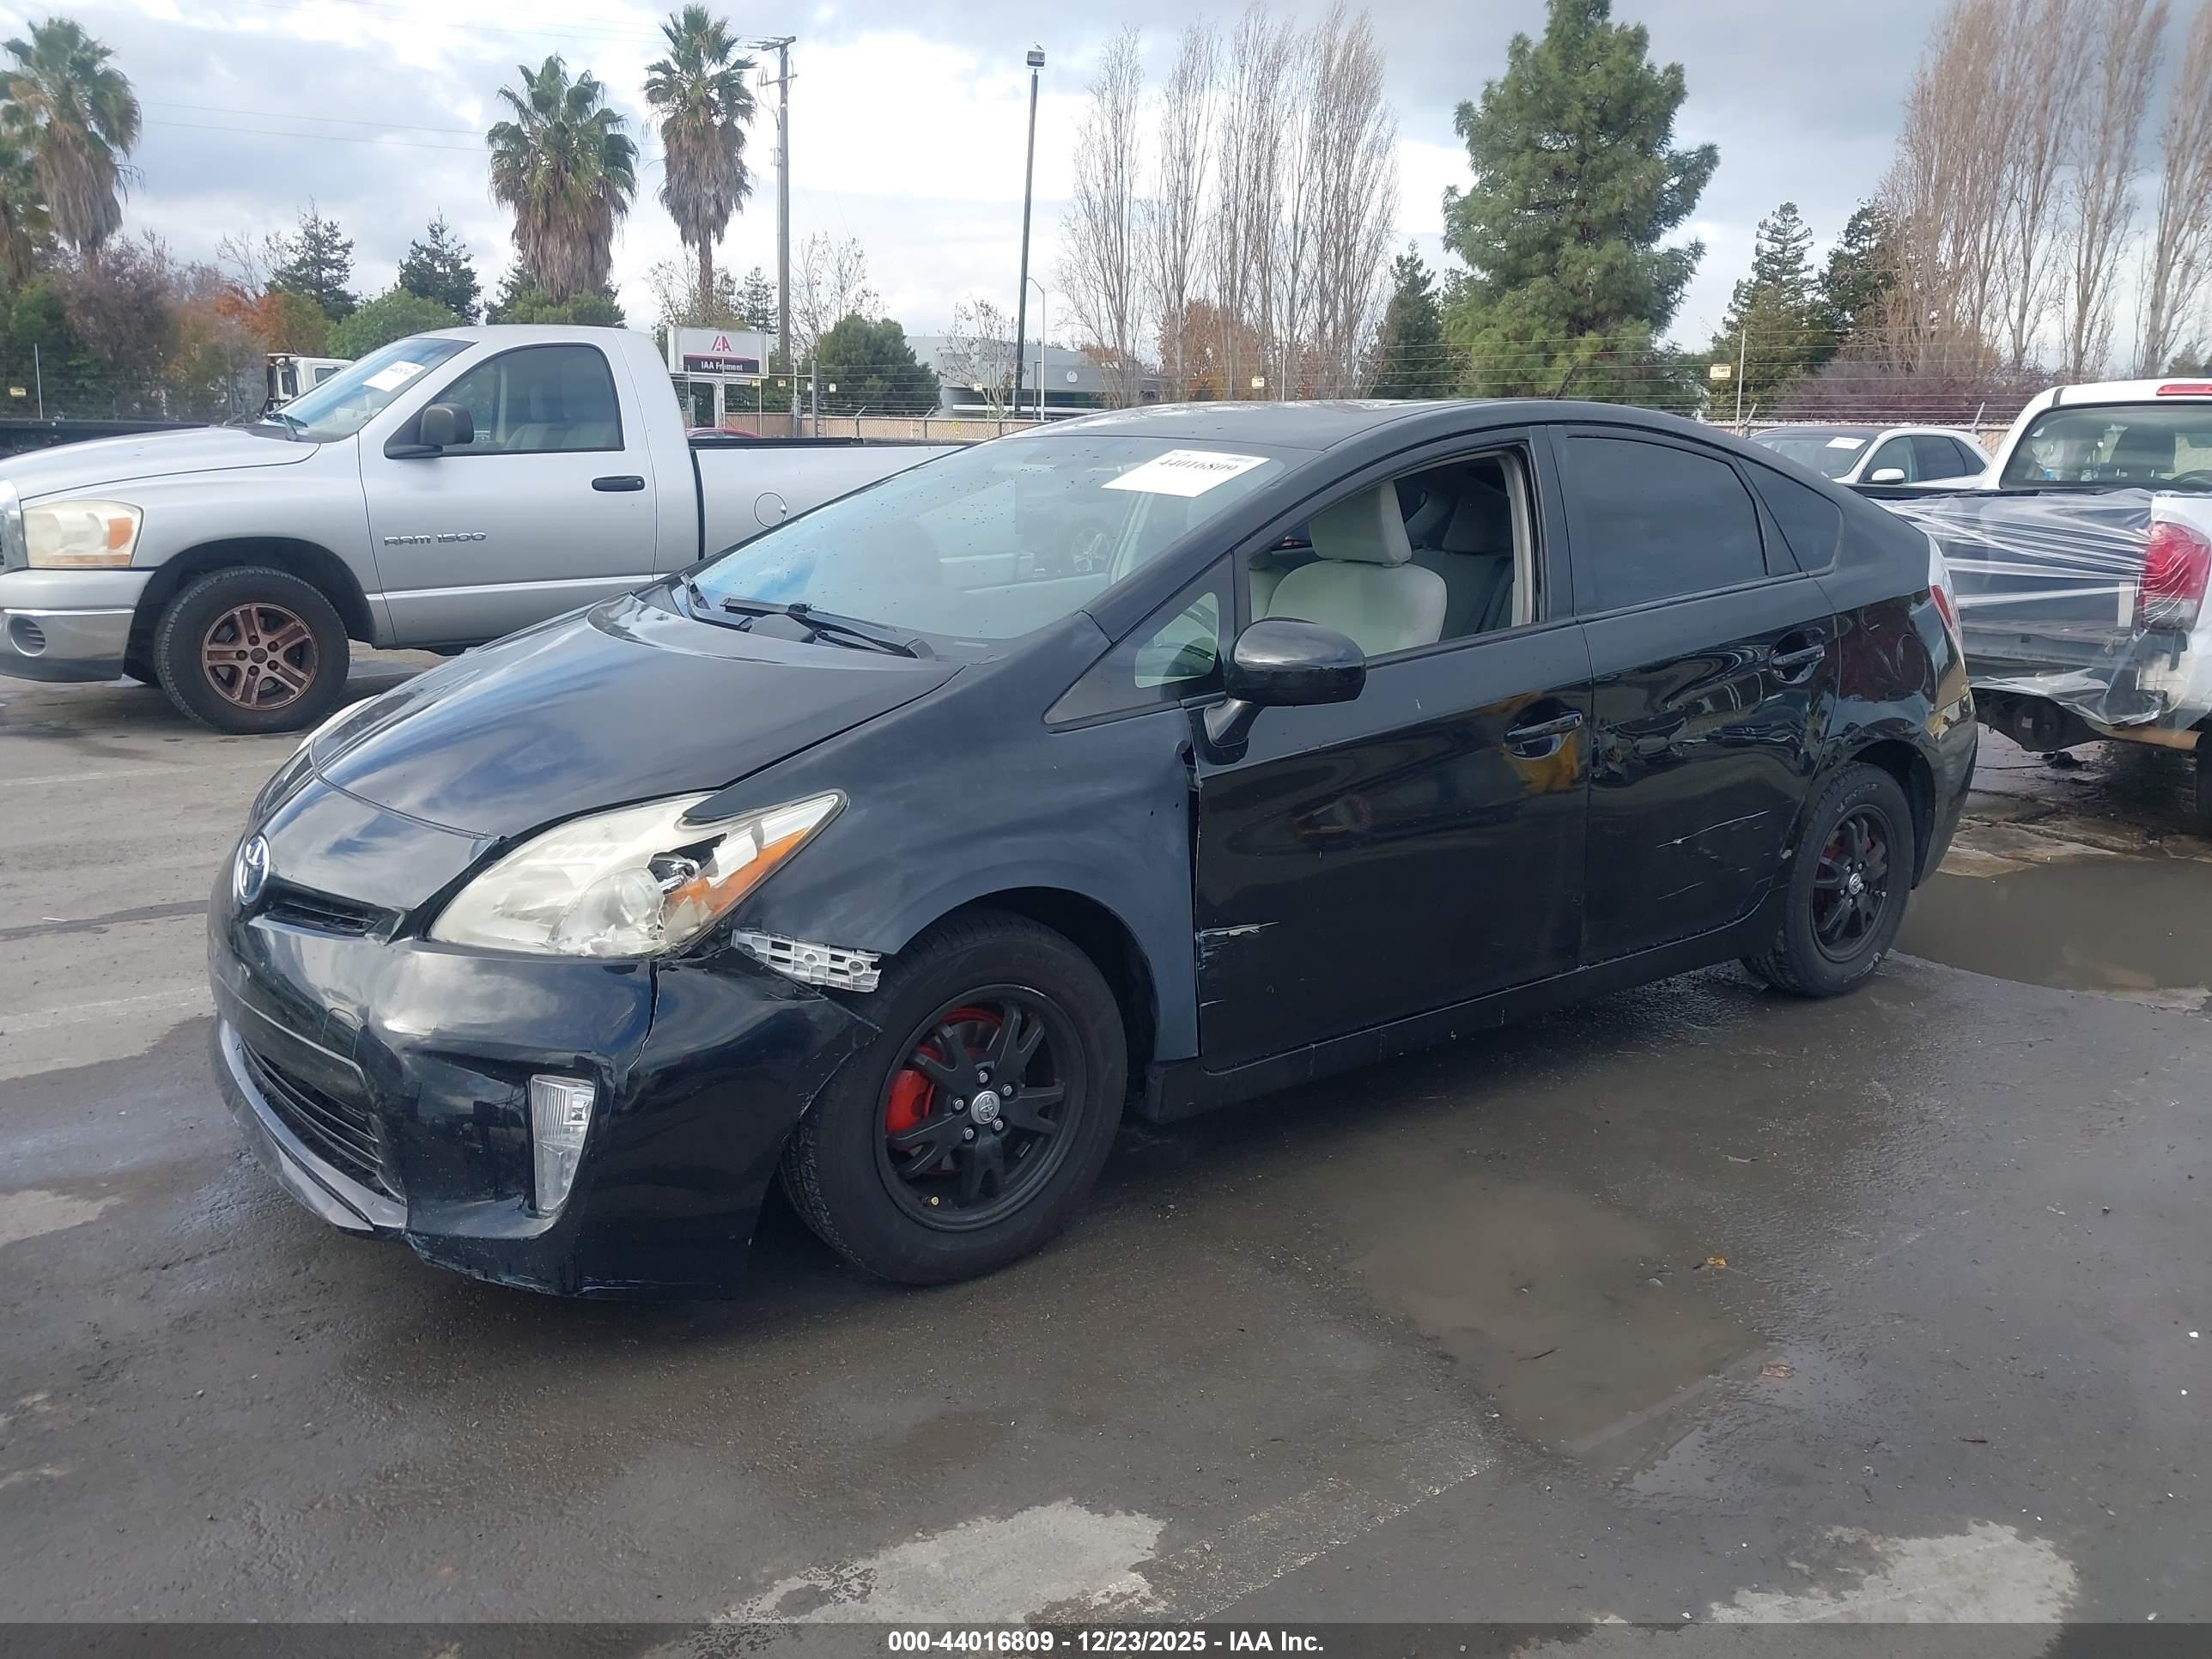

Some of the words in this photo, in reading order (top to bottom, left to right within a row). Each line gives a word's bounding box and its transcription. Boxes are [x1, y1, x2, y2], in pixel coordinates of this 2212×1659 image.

[701, 361, 714, 370] IAA
[1159, 459, 1239, 471] 44016809
[384, 536, 431, 546] RAM
[436, 532, 487, 544] 1500
